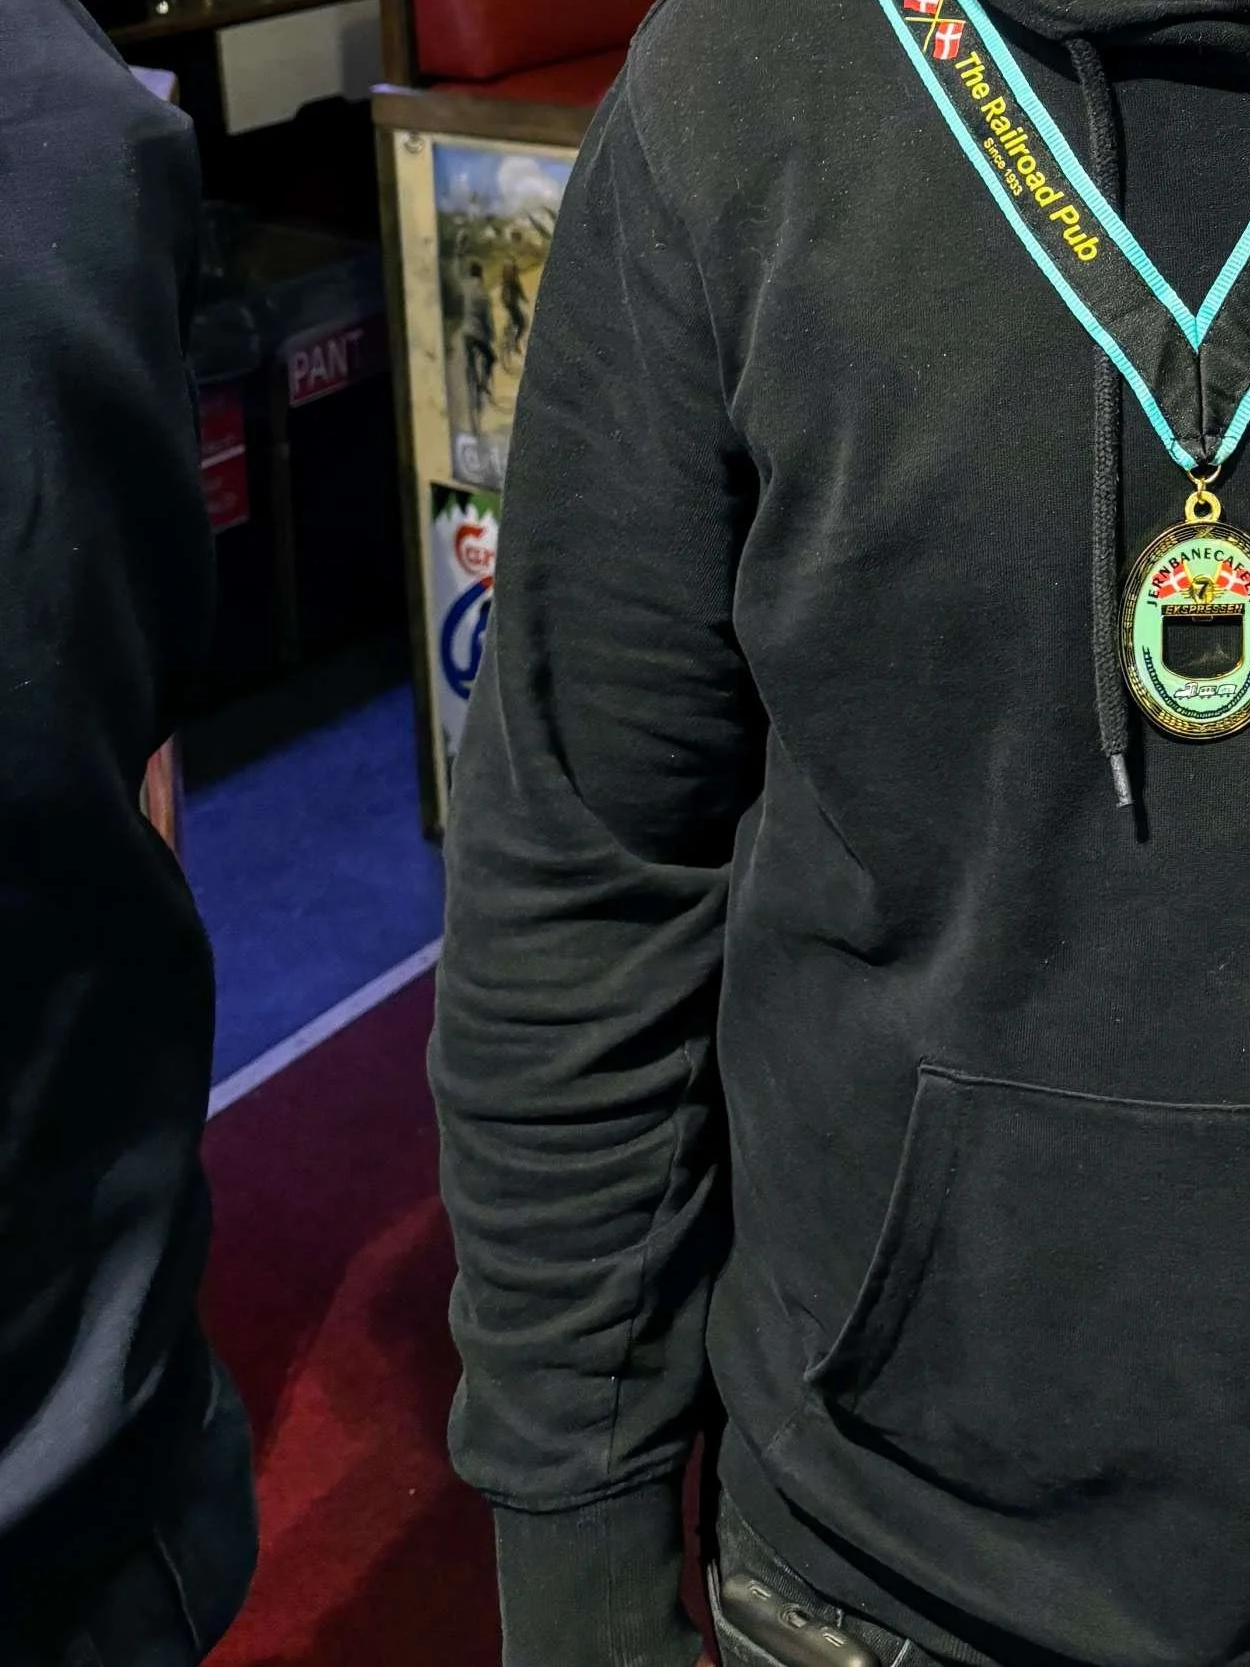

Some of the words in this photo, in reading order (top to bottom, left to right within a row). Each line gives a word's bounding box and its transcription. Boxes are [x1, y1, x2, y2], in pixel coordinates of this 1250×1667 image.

[955, 51, 990, 100] The
[981, 96, 1065, 208] Railroad
[1049, 204, 1099, 261] Pub
[983, 137, 1006, 170] Since
[1004, 168, 1023, 196] 1933
[290, 328, 364, 394] PANT
[1166, 604, 1243, 614] EKSPRESSEN
[1196, 581, 1208, 599] 7
